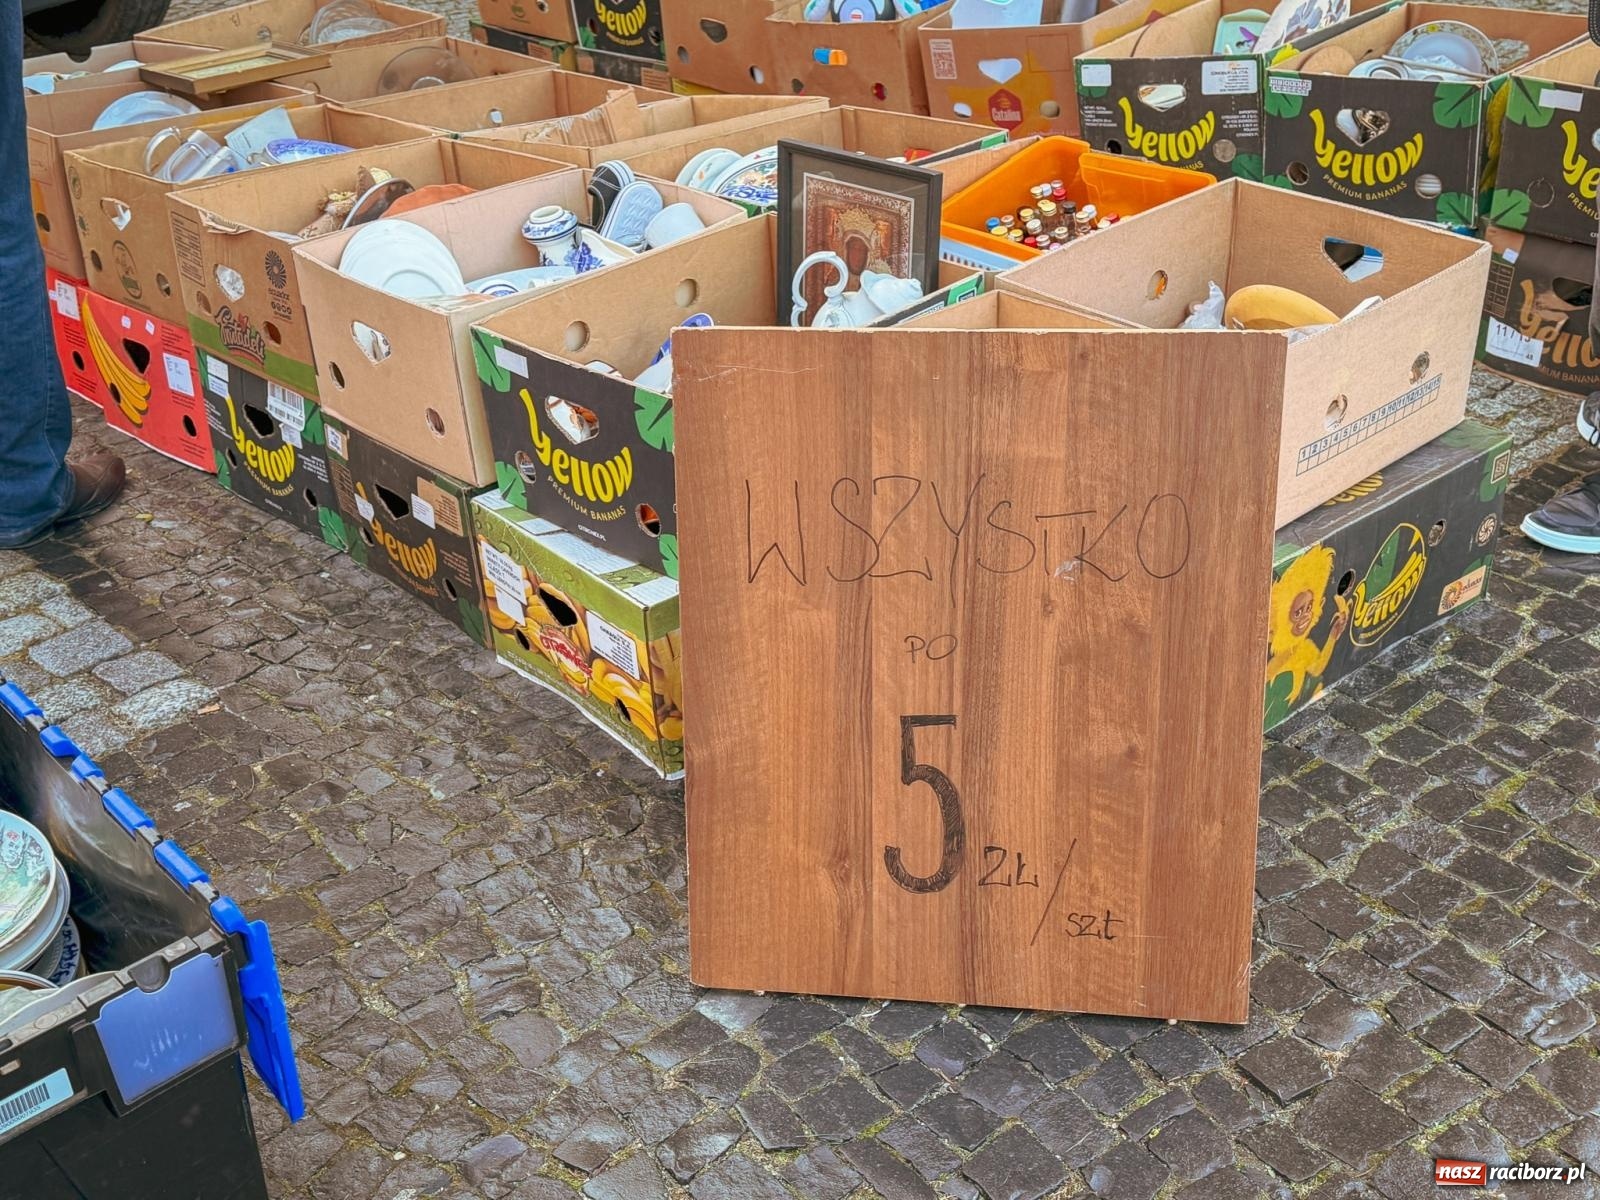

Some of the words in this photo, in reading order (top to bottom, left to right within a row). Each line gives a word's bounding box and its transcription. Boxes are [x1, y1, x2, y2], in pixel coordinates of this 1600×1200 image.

[1322, 173, 1363, 199] PREMIUM
[1365, 180, 1408, 201] BANANAS
[1567, 192, 1600, 220] PREMIU
[1519, 278, 1600, 369] yello
[1562, 372, 1600, 384] BANANA
[547, 474, 589, 516] PREMIUM
[590, 504, 627, 522] BANANAS
[745, 472, 1192, 608] WSZYSTKO
[904, 633, 958, 663] PO
[883, 714, 967, 894] 5
